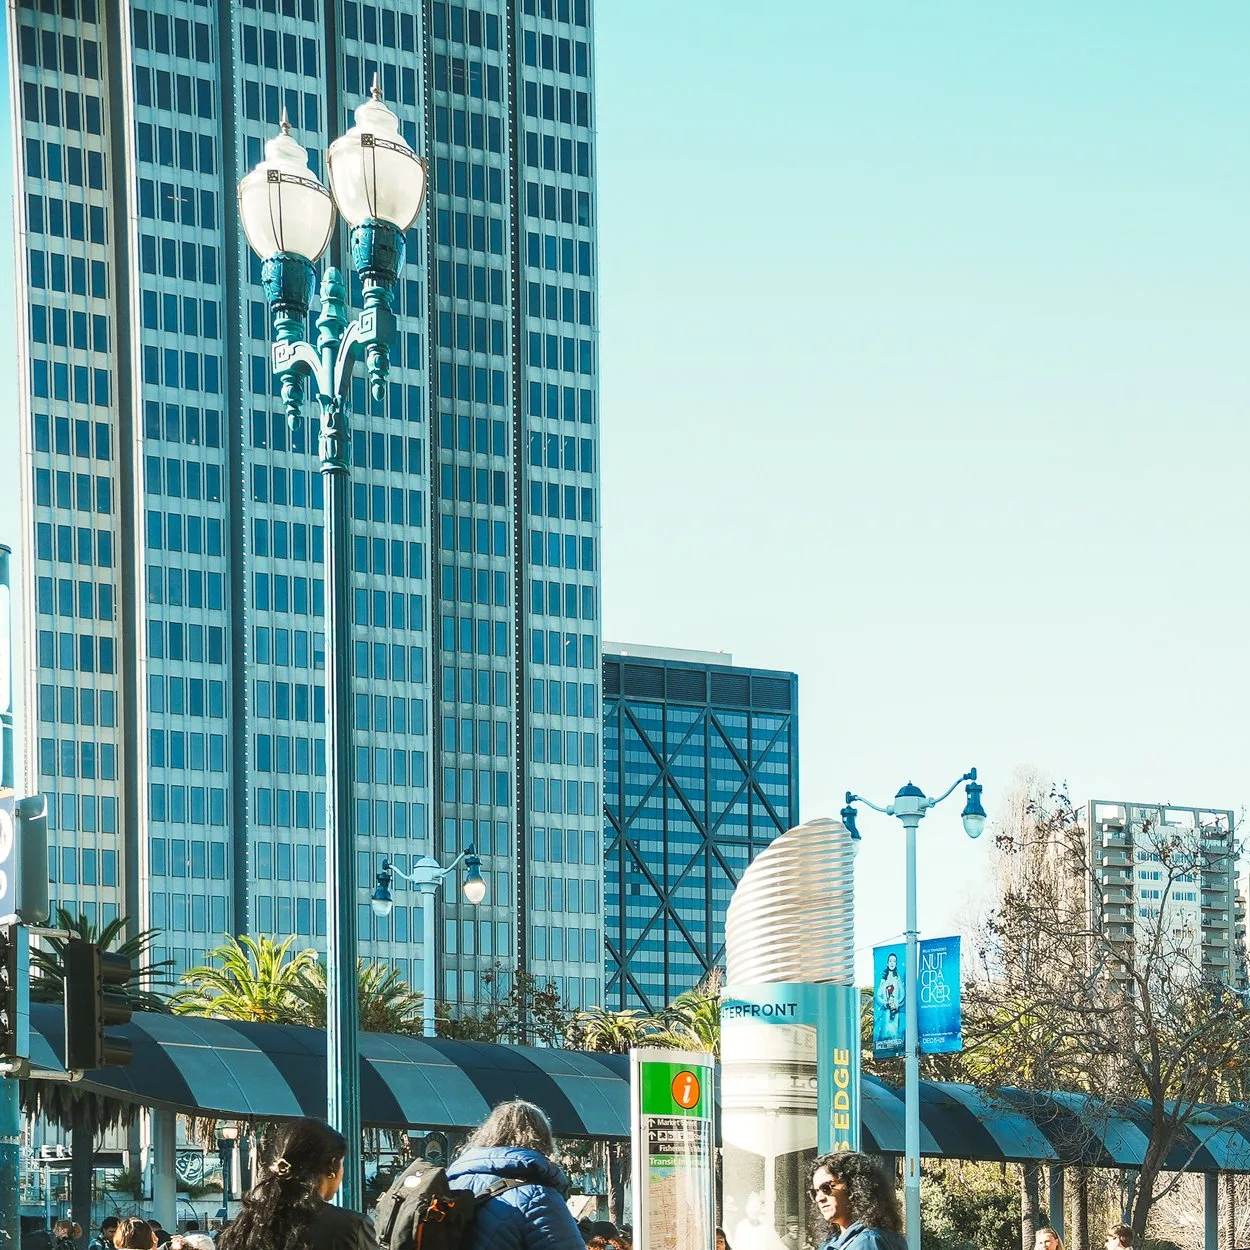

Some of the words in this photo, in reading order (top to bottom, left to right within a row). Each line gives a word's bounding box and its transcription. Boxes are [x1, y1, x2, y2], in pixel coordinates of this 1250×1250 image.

[922, 952, 948, 970] NUT
[722, 1003, 797, 1018] TERFRONT
[834, 1048, 850, 1130] EDGE
[657, 1118, 680, 1127] Market
[650, 1157, 676, 1165] Transit
